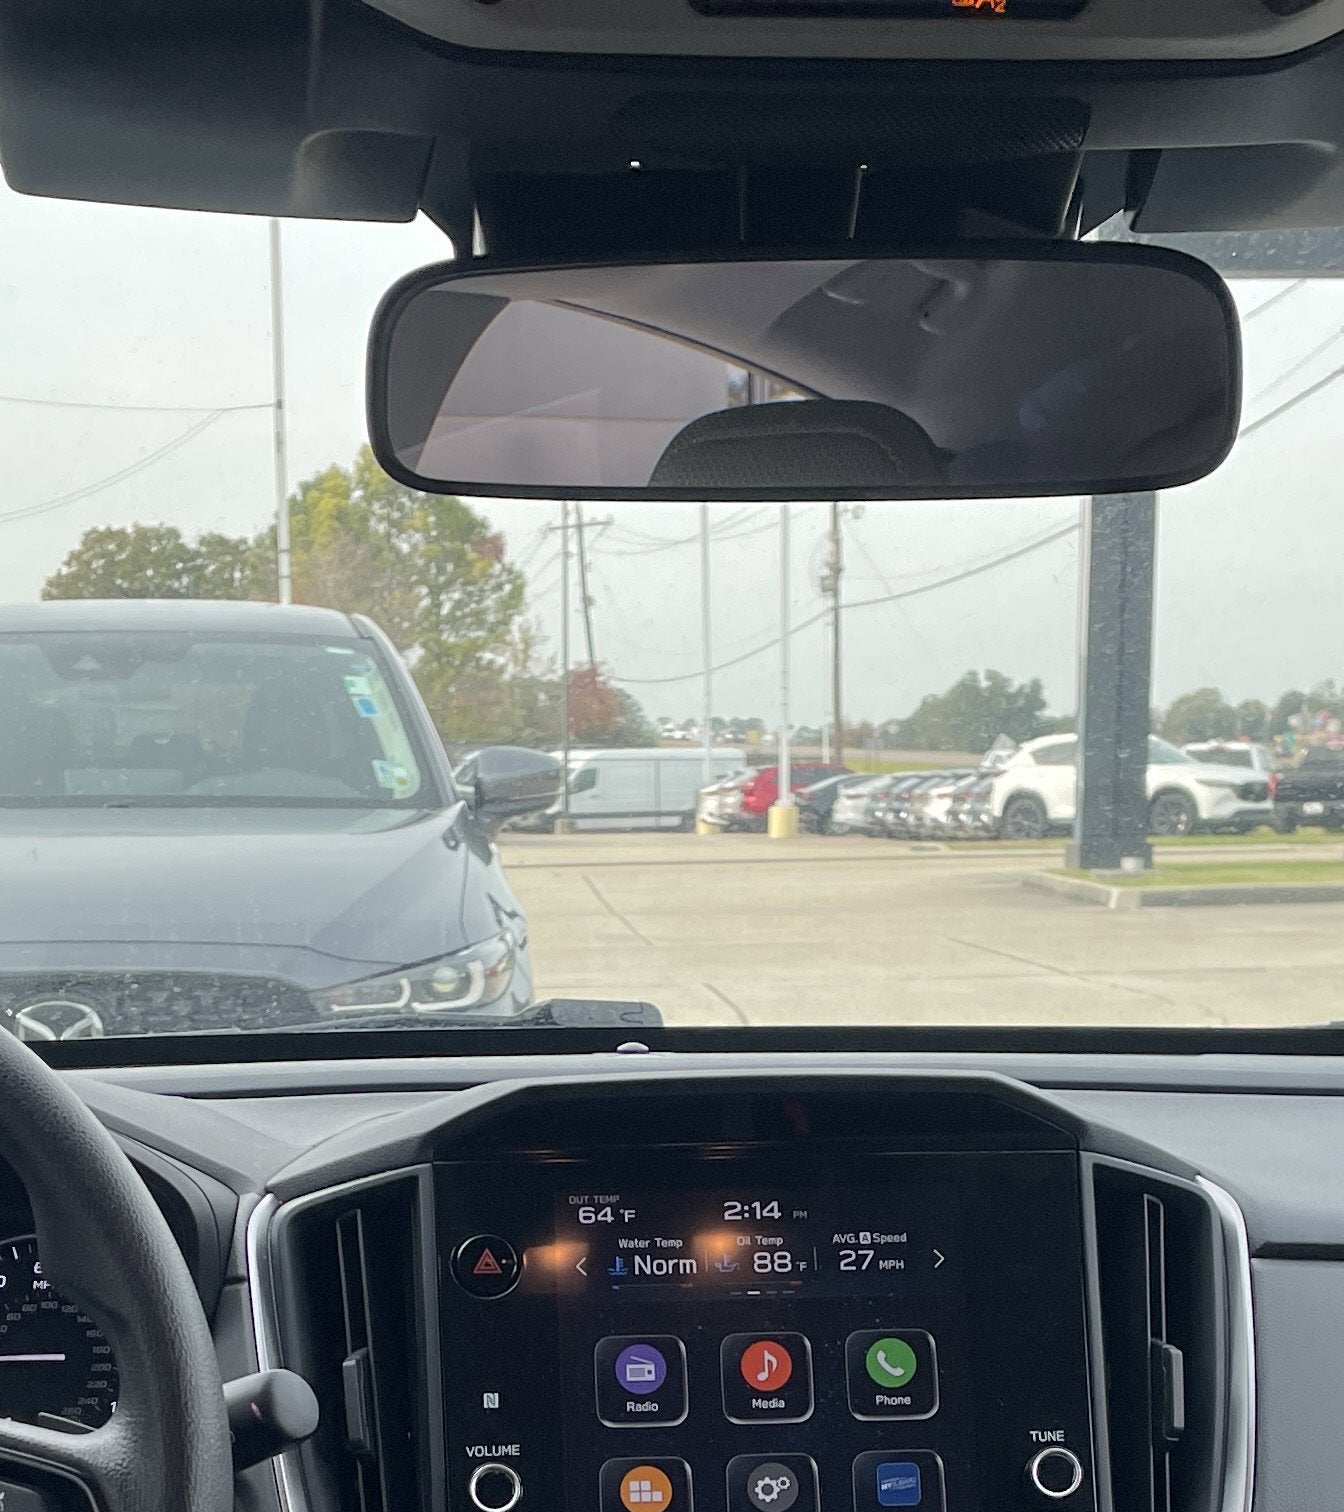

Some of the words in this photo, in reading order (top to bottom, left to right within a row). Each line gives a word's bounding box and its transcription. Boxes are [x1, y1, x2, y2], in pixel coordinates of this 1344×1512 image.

[568, 1196, 589, 1205] OUT
[593, 1195, 620, 1204] TEMP
[578, 1207, 614, 1224] 64
[723, 1201, 782, 1220] 2:14
[792, 1210, 808, 1219] PM
[618, 1238, 650, 1249] Water
[654, 1238, 683, 1249] Temp
[737, 1236, 751, 1246] Oil
[755, 1235, 784, 1247] Temp
[872, 1232, 907, 1245] Speed
[633, 1255, 697, 1275] Norm
[753, 1251, 792, 1273] 88
[838, 1249, 875, 1271] 27
[879, 1260, 905, 1270] MPH
[626, 1401, 659, 1412] Radio
[751, 1399, 785, 1409] Media
[875, 1395, 912, 1406] Phone
[1029, 1430, 1065, 1442] TUNE
[465, 1444, 521, 1457] VOLUME
